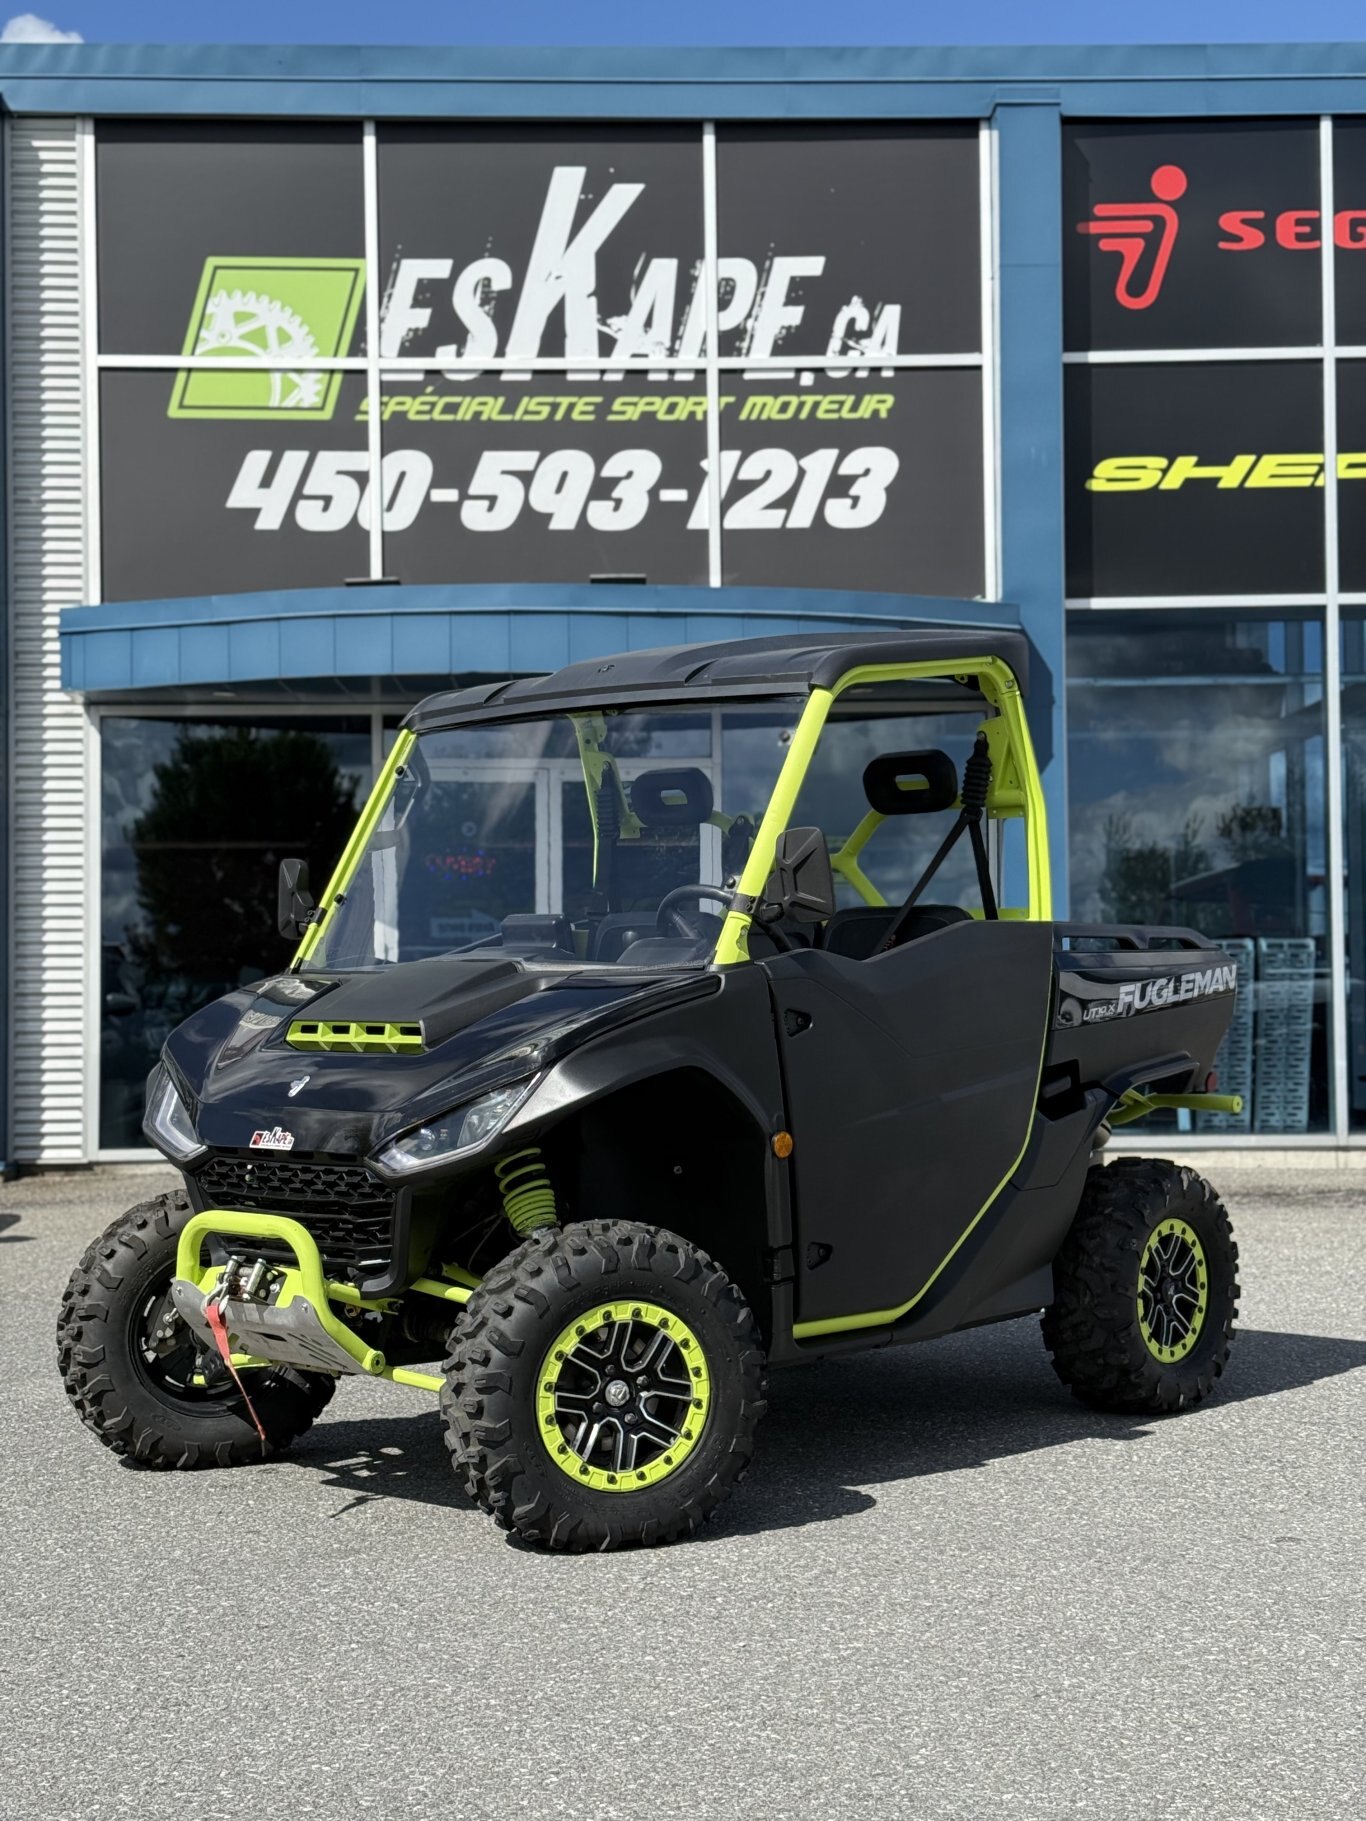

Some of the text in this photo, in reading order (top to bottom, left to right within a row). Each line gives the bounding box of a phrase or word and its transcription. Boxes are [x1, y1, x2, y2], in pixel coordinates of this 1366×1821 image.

[355, 386, 604, 421] SPÉCIALISTE
[739, 393, 895, 421] MOTEUR
[226, 446, 900, 533] 450-593-1213
[1117, 965, 1237, 1013] FUGLEMAN
